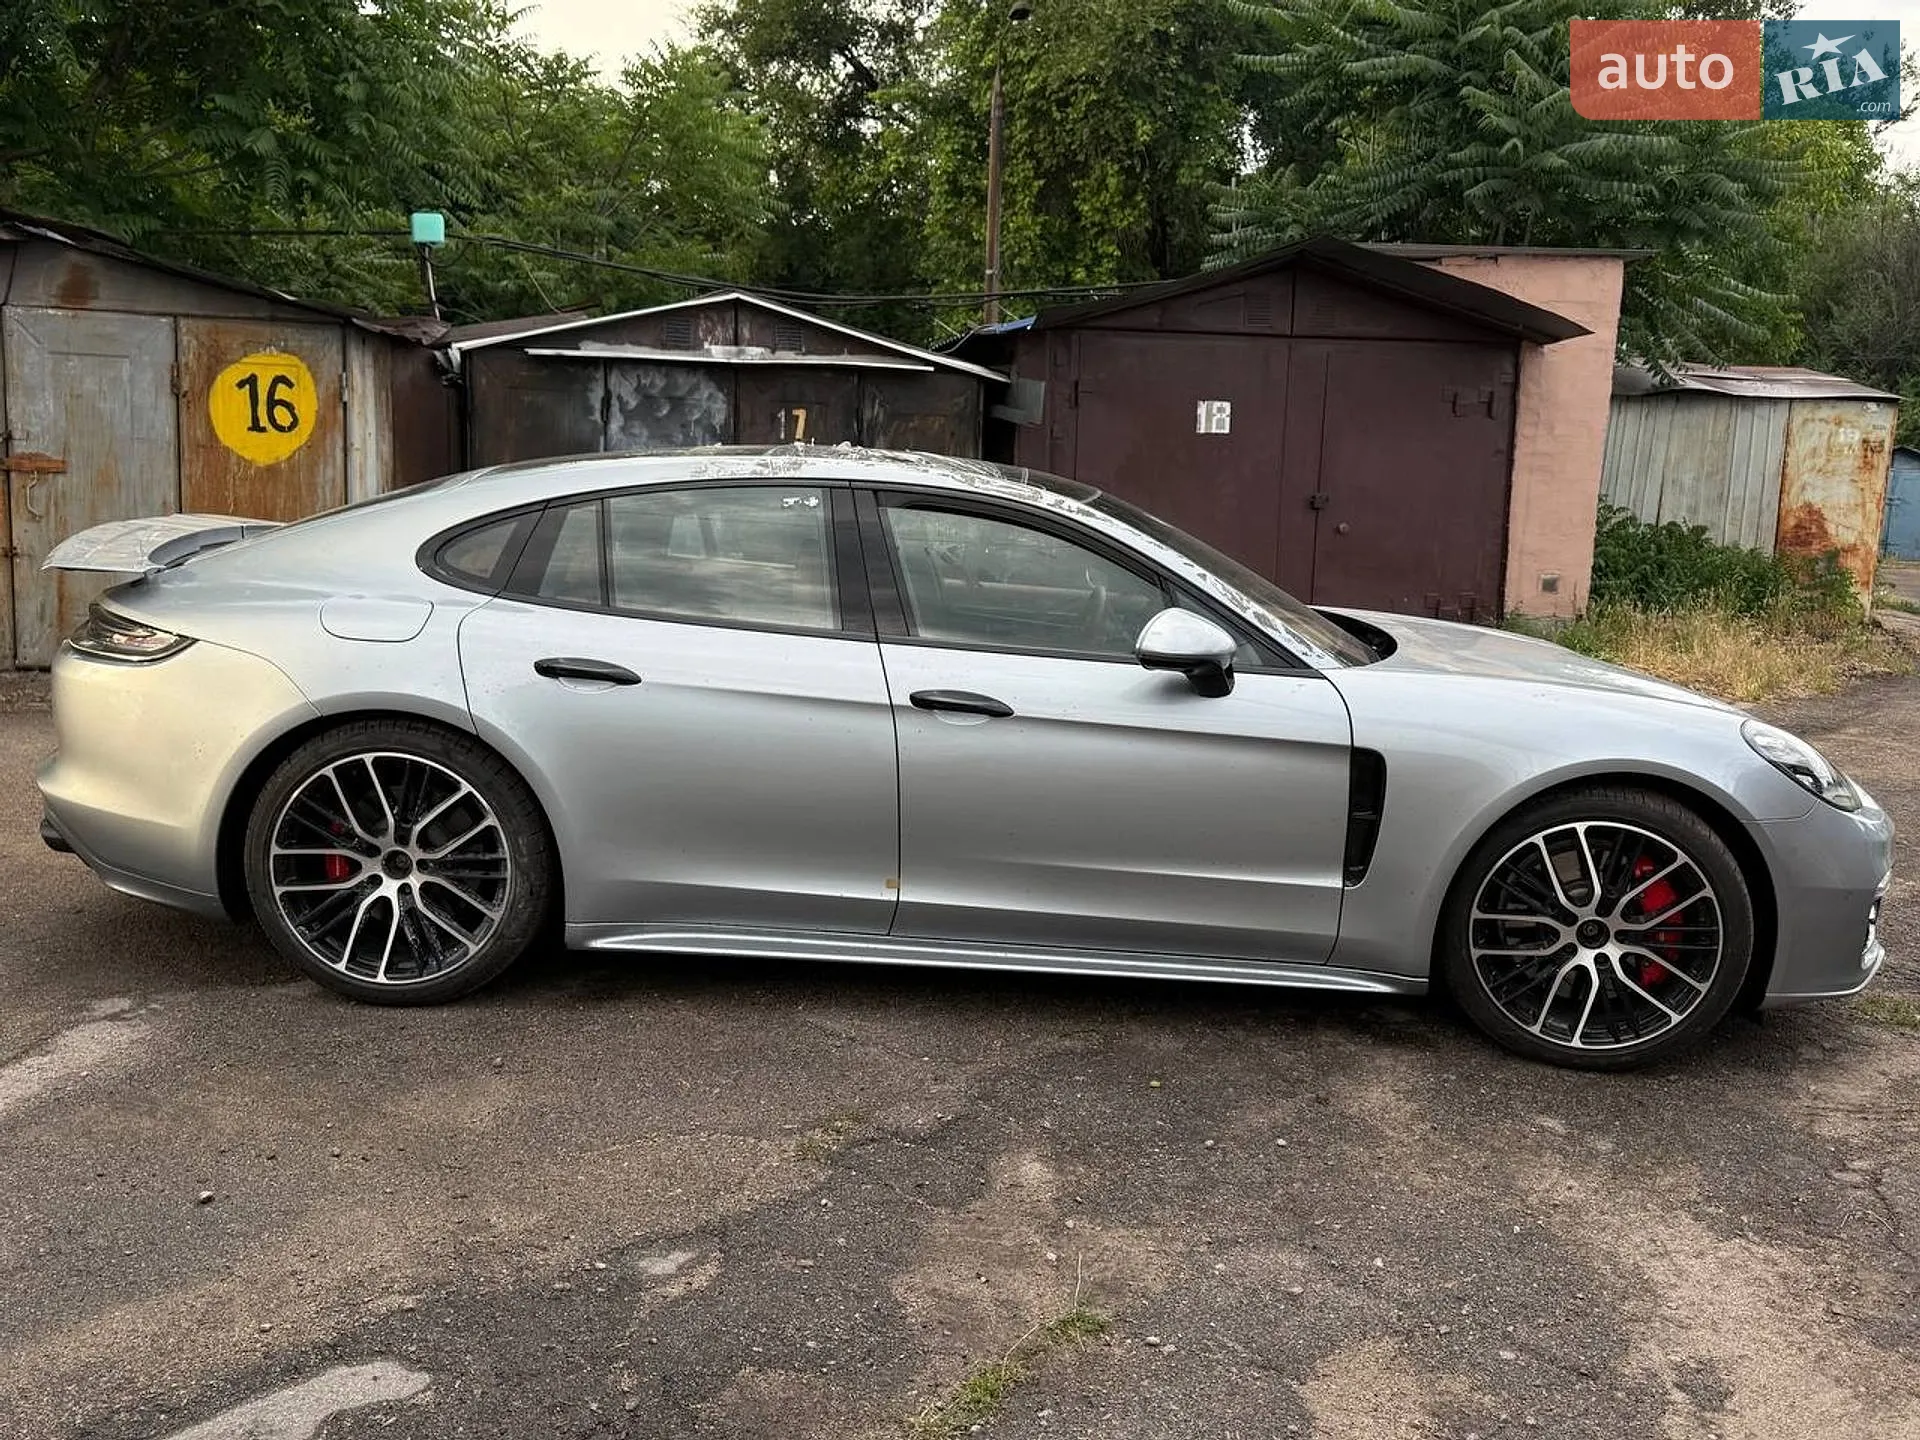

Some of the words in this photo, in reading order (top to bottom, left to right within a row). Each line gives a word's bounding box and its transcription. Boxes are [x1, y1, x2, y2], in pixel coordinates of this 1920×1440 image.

[235, 373, 299, 433] 16
[1196, 400, 1231, 434] 18
[777, 407, 807, 440] 17
